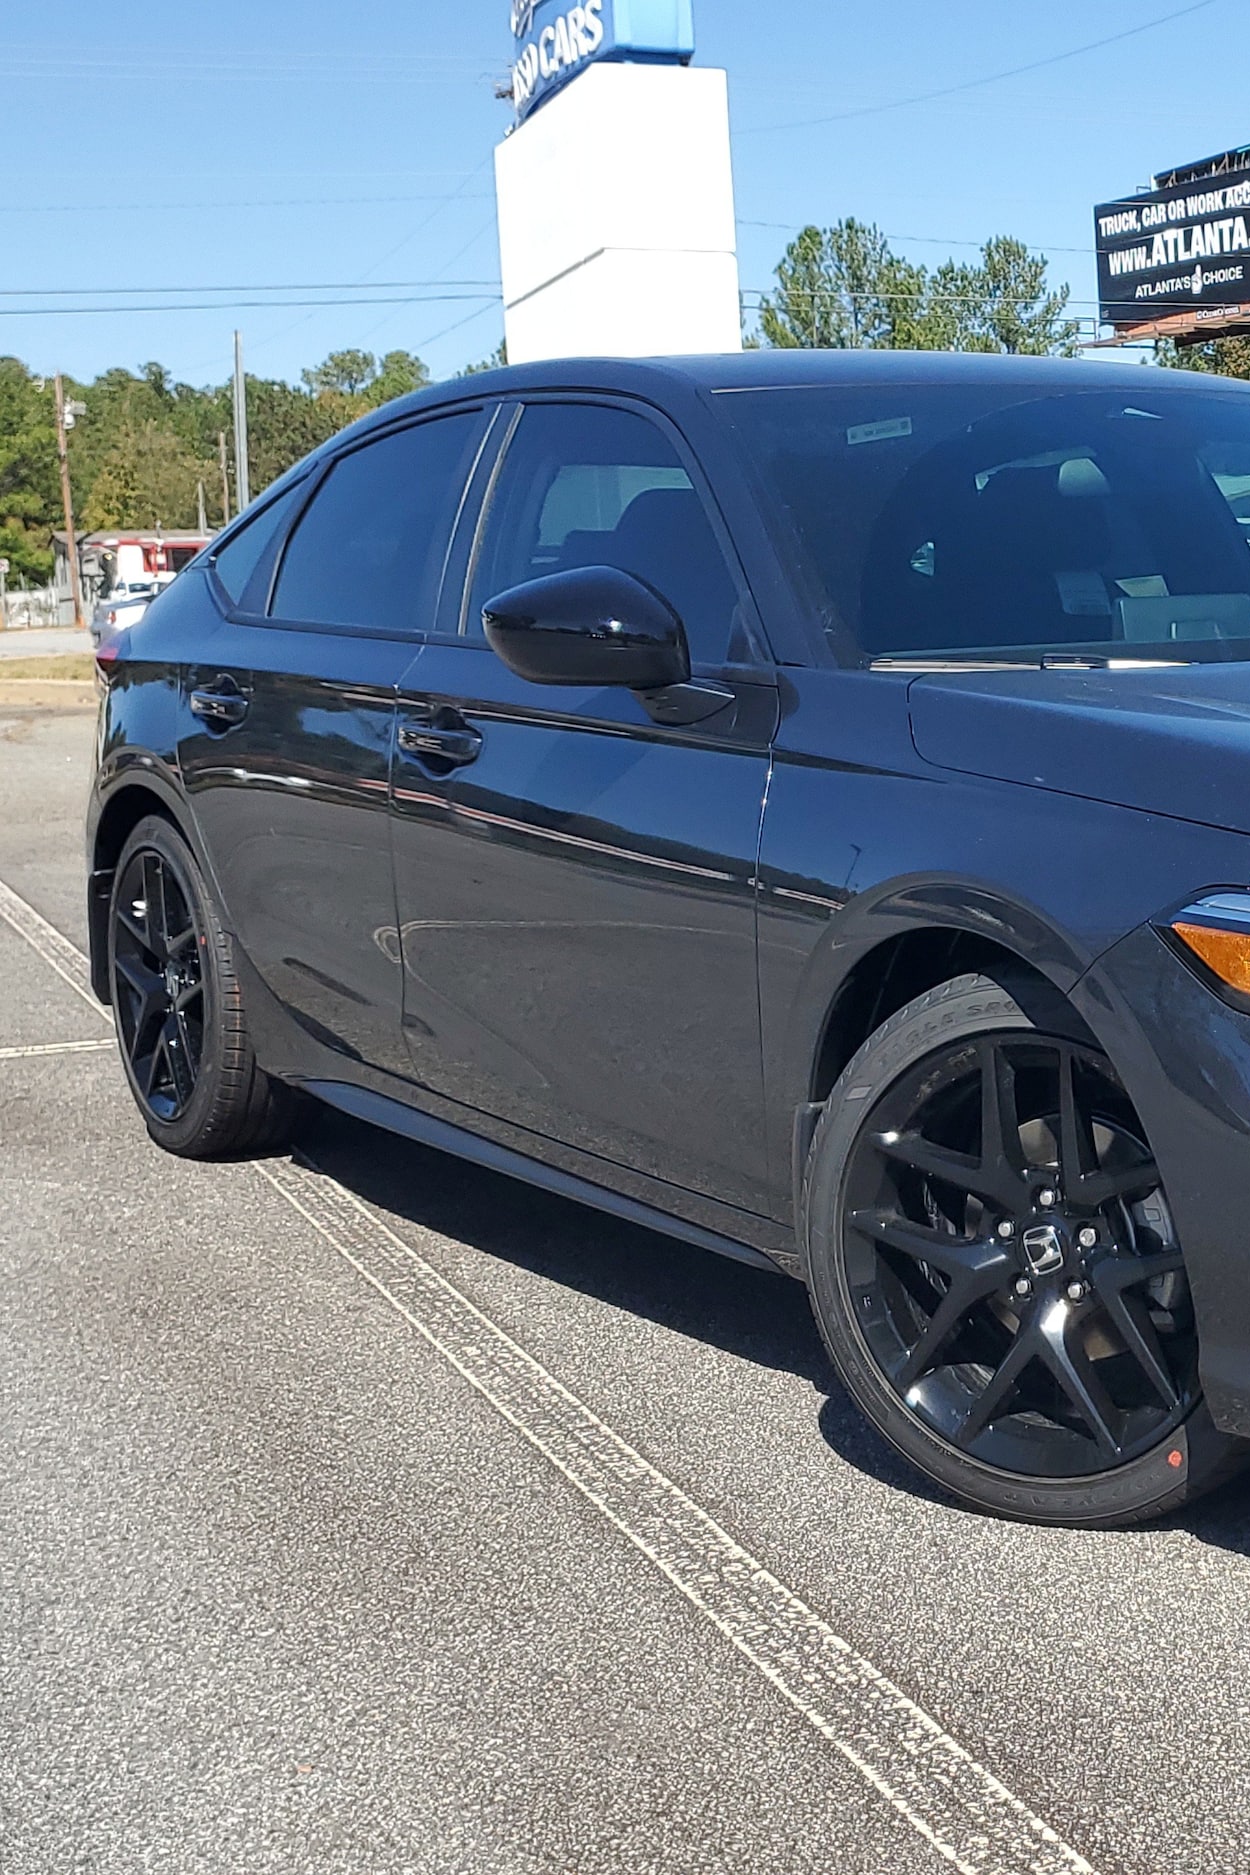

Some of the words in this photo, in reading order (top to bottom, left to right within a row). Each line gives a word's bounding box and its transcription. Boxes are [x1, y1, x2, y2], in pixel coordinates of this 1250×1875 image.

[539, 0, 603, 79] CARS
[1099, 210, 1142, 237] TRUCK,
[1142, 204, 1167, 227] CAR
[1168, 199, 1186, 219] OR
[1186, 190, 1224, 217] WORK
[1135, 276, 1191, 298] ATLANTA'S
[1202, 266, 1244, 285] CHOICE
